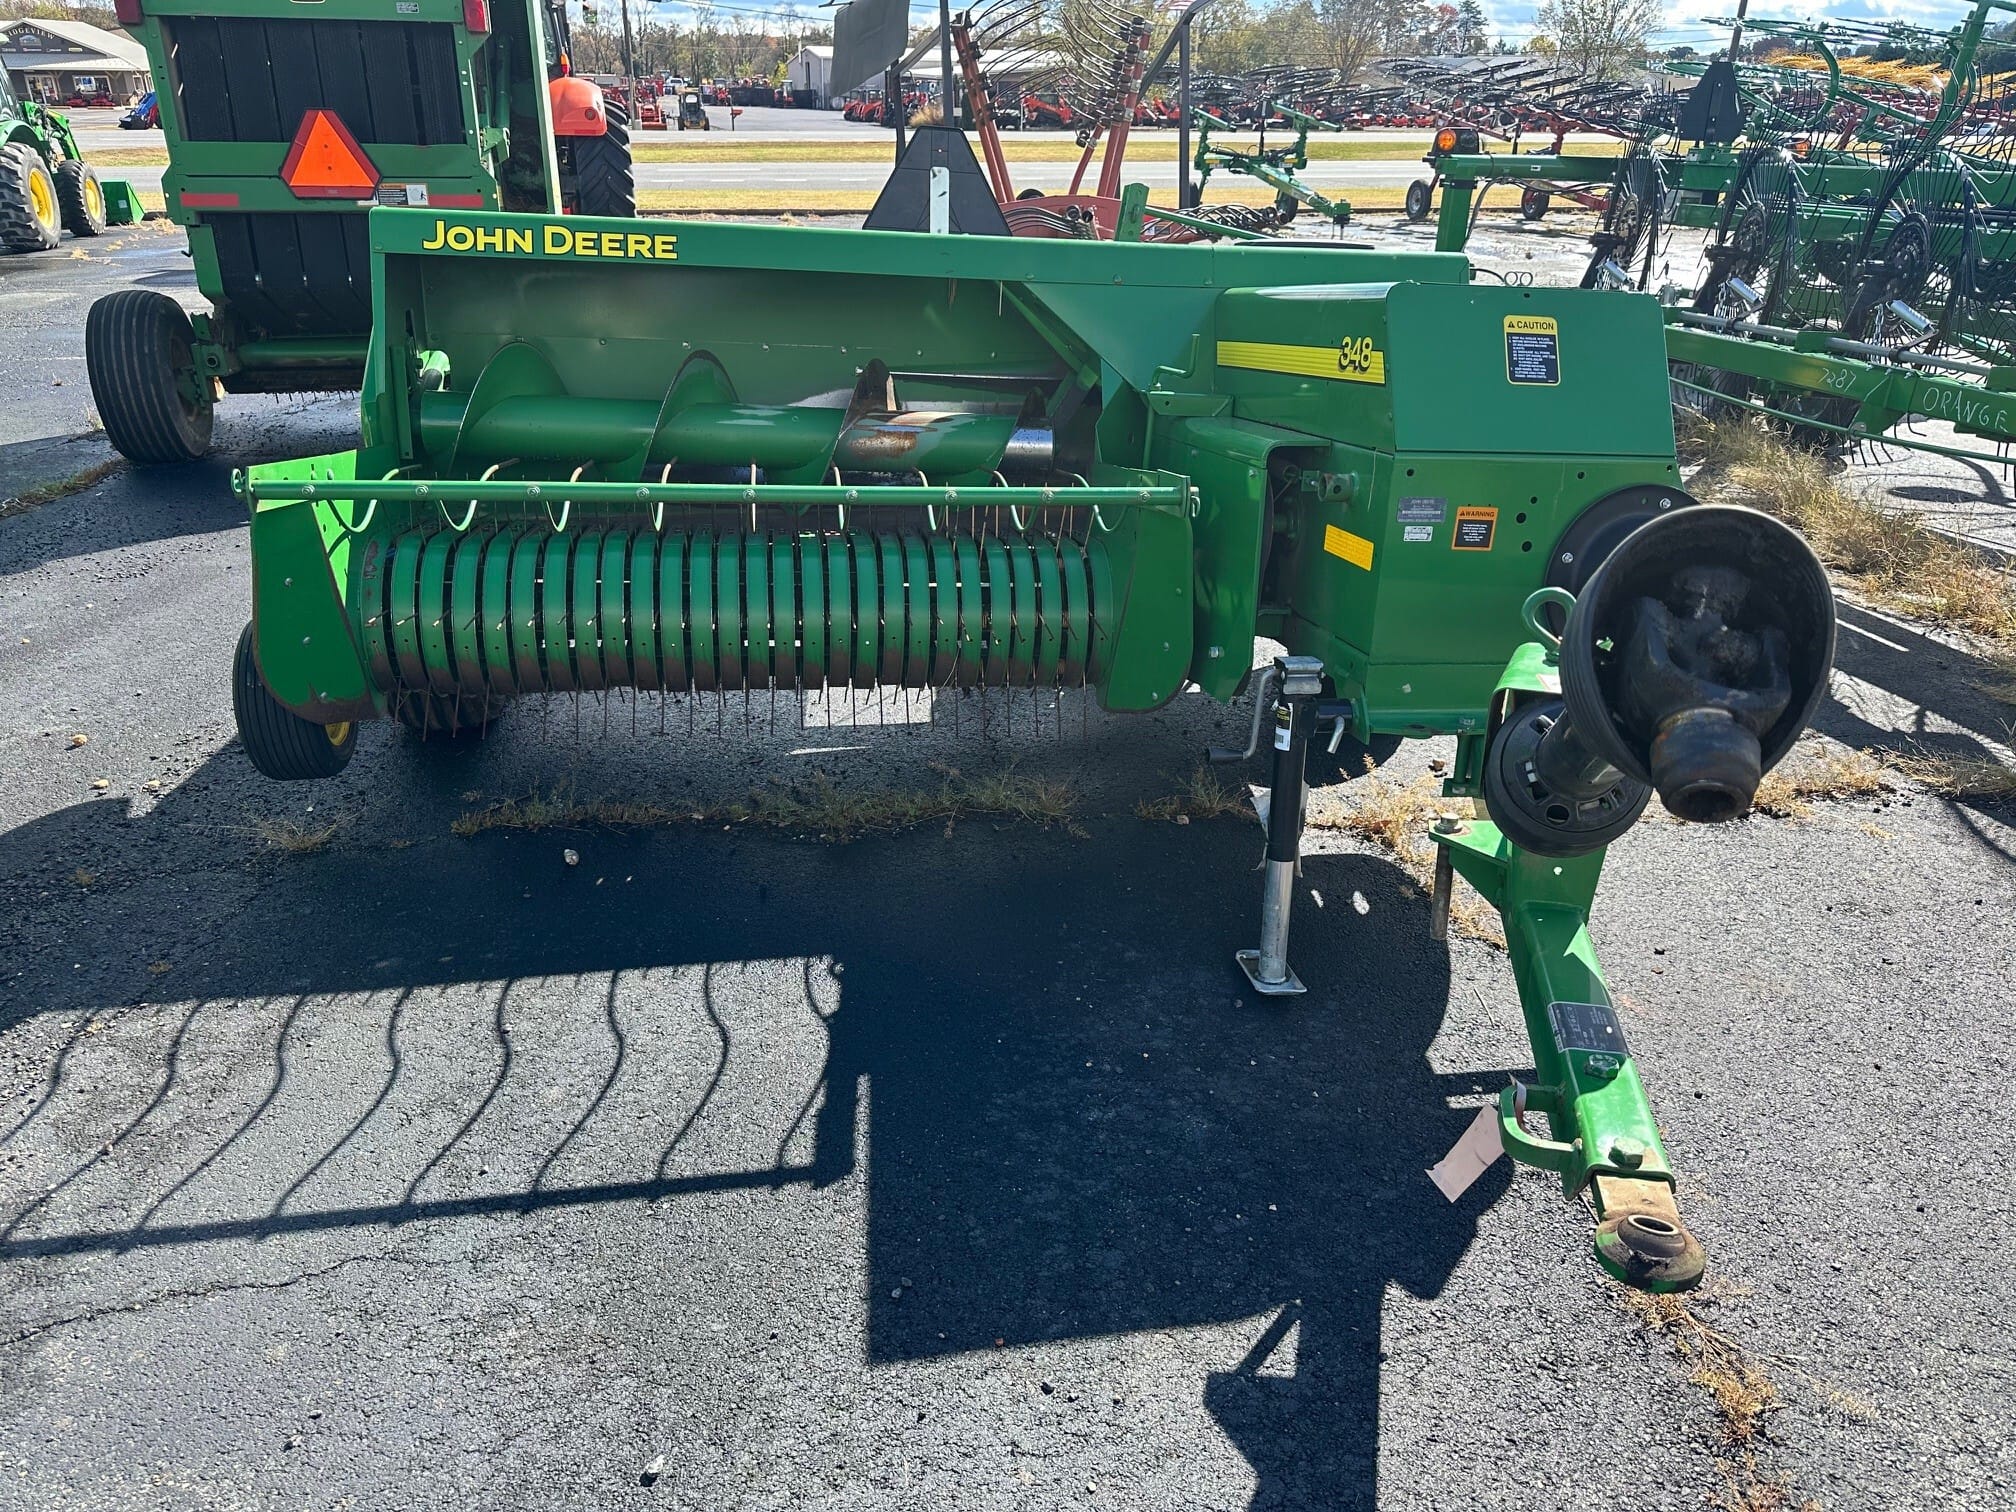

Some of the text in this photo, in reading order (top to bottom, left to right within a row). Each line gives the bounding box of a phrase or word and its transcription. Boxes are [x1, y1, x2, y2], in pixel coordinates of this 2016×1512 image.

[422, 219, 679, 260] JOHN DEERE
[1516, 320, 1554, 331] CAUTION
[1339, 335, 1373, 371] 348
[1922, 386, 2009, 433] ORANGE
[1465, 510, 1495, 518] WARNING
